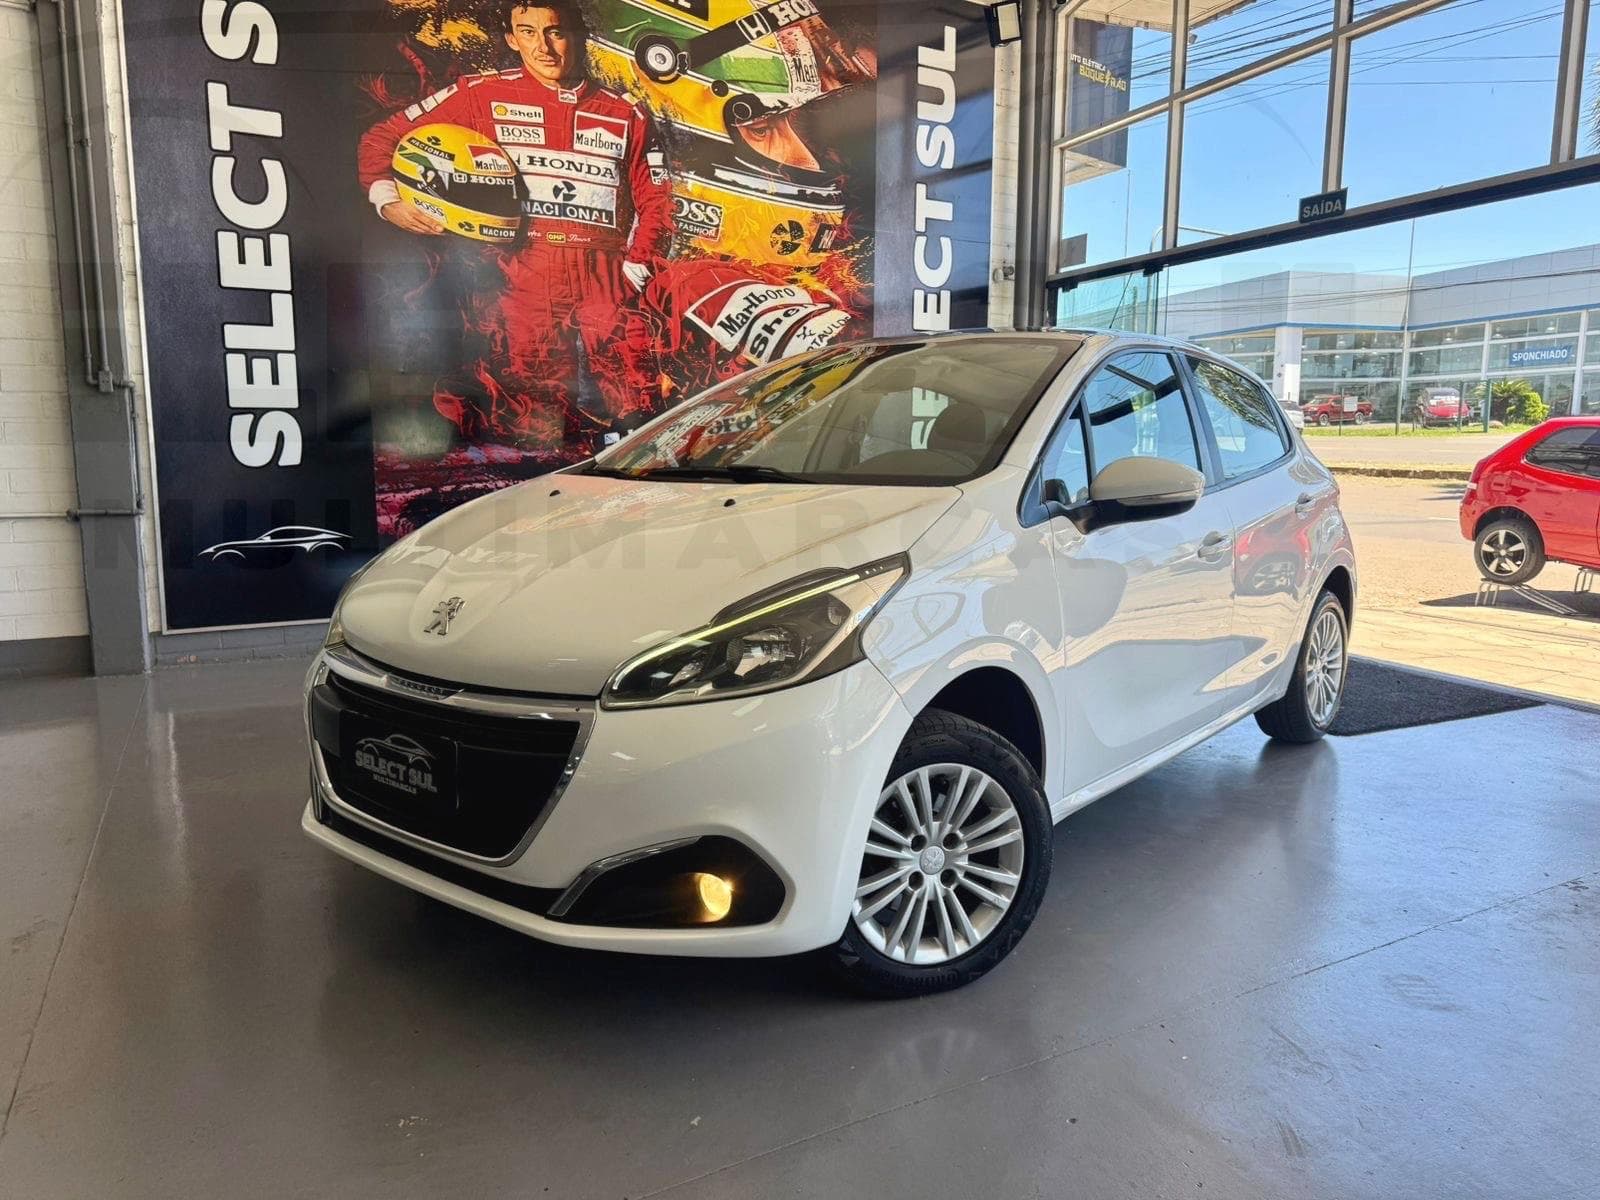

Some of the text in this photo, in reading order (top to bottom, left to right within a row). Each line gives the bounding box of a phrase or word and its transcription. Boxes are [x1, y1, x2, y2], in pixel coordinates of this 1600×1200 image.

[1071, 53, 1081, 63] UTO
[917, 25, 957, 169] SUL
[509, 109, 542, 119] Shell
[500, 126, 541, 139] BOSS
[575, 132, 623, 152] Marlboro
[410, 138, 451, 160] NACIONAL
[527, 155, 616, 180] HONDA
[521, 201, 609, 223] NACIONAL
[672, 197, 721, 226] OSS
[1302, 199, 1343, 218] SAÍDA
[679, 221, 716, 237] FASHION
[207, 82, 302, 467] SELECT
[717, 288, 795, 337] Marlboro
[1512, 349, 1568, 362] SPONCHIADO
[355, 750, 438, 793] SELECT SUL
